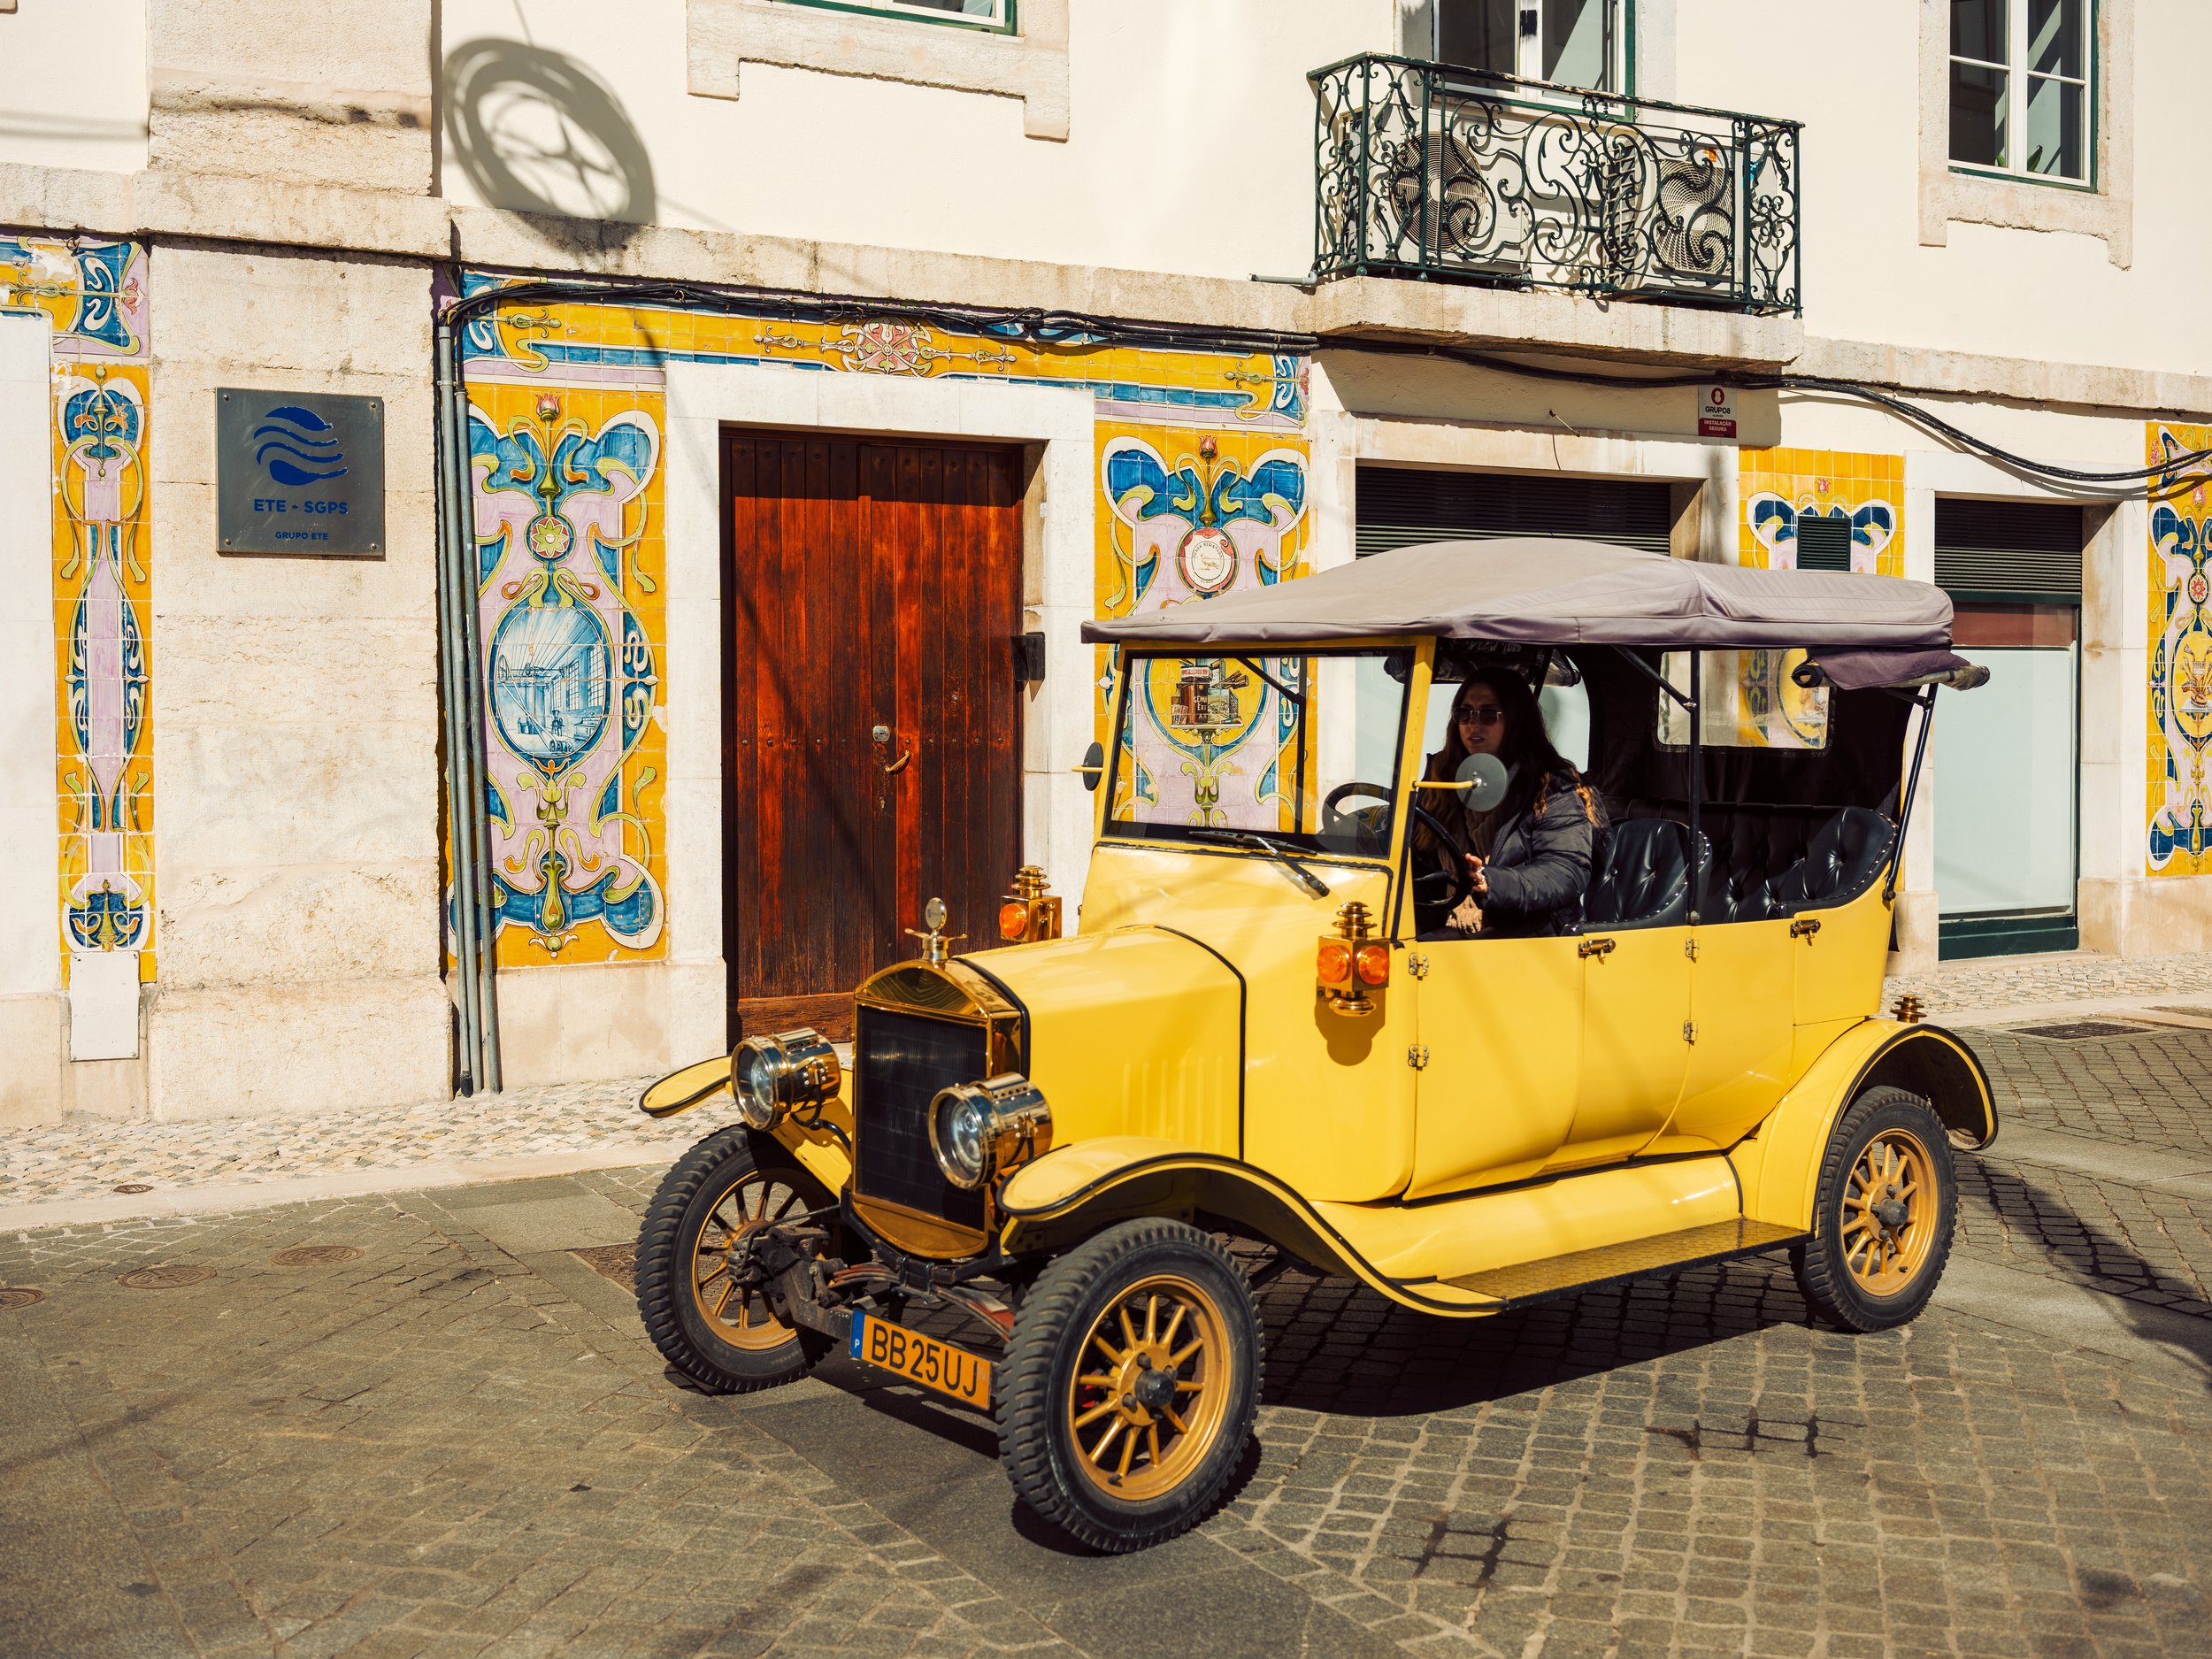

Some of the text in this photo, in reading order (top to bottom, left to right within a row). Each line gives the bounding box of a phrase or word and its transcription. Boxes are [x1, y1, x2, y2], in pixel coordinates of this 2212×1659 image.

[254, 498, 287, 512] ETE
[303, 500, 349, 515] SGPS
[275, 531, 309, 540] GRUPO
[854, 1338, 861, 1349] P
